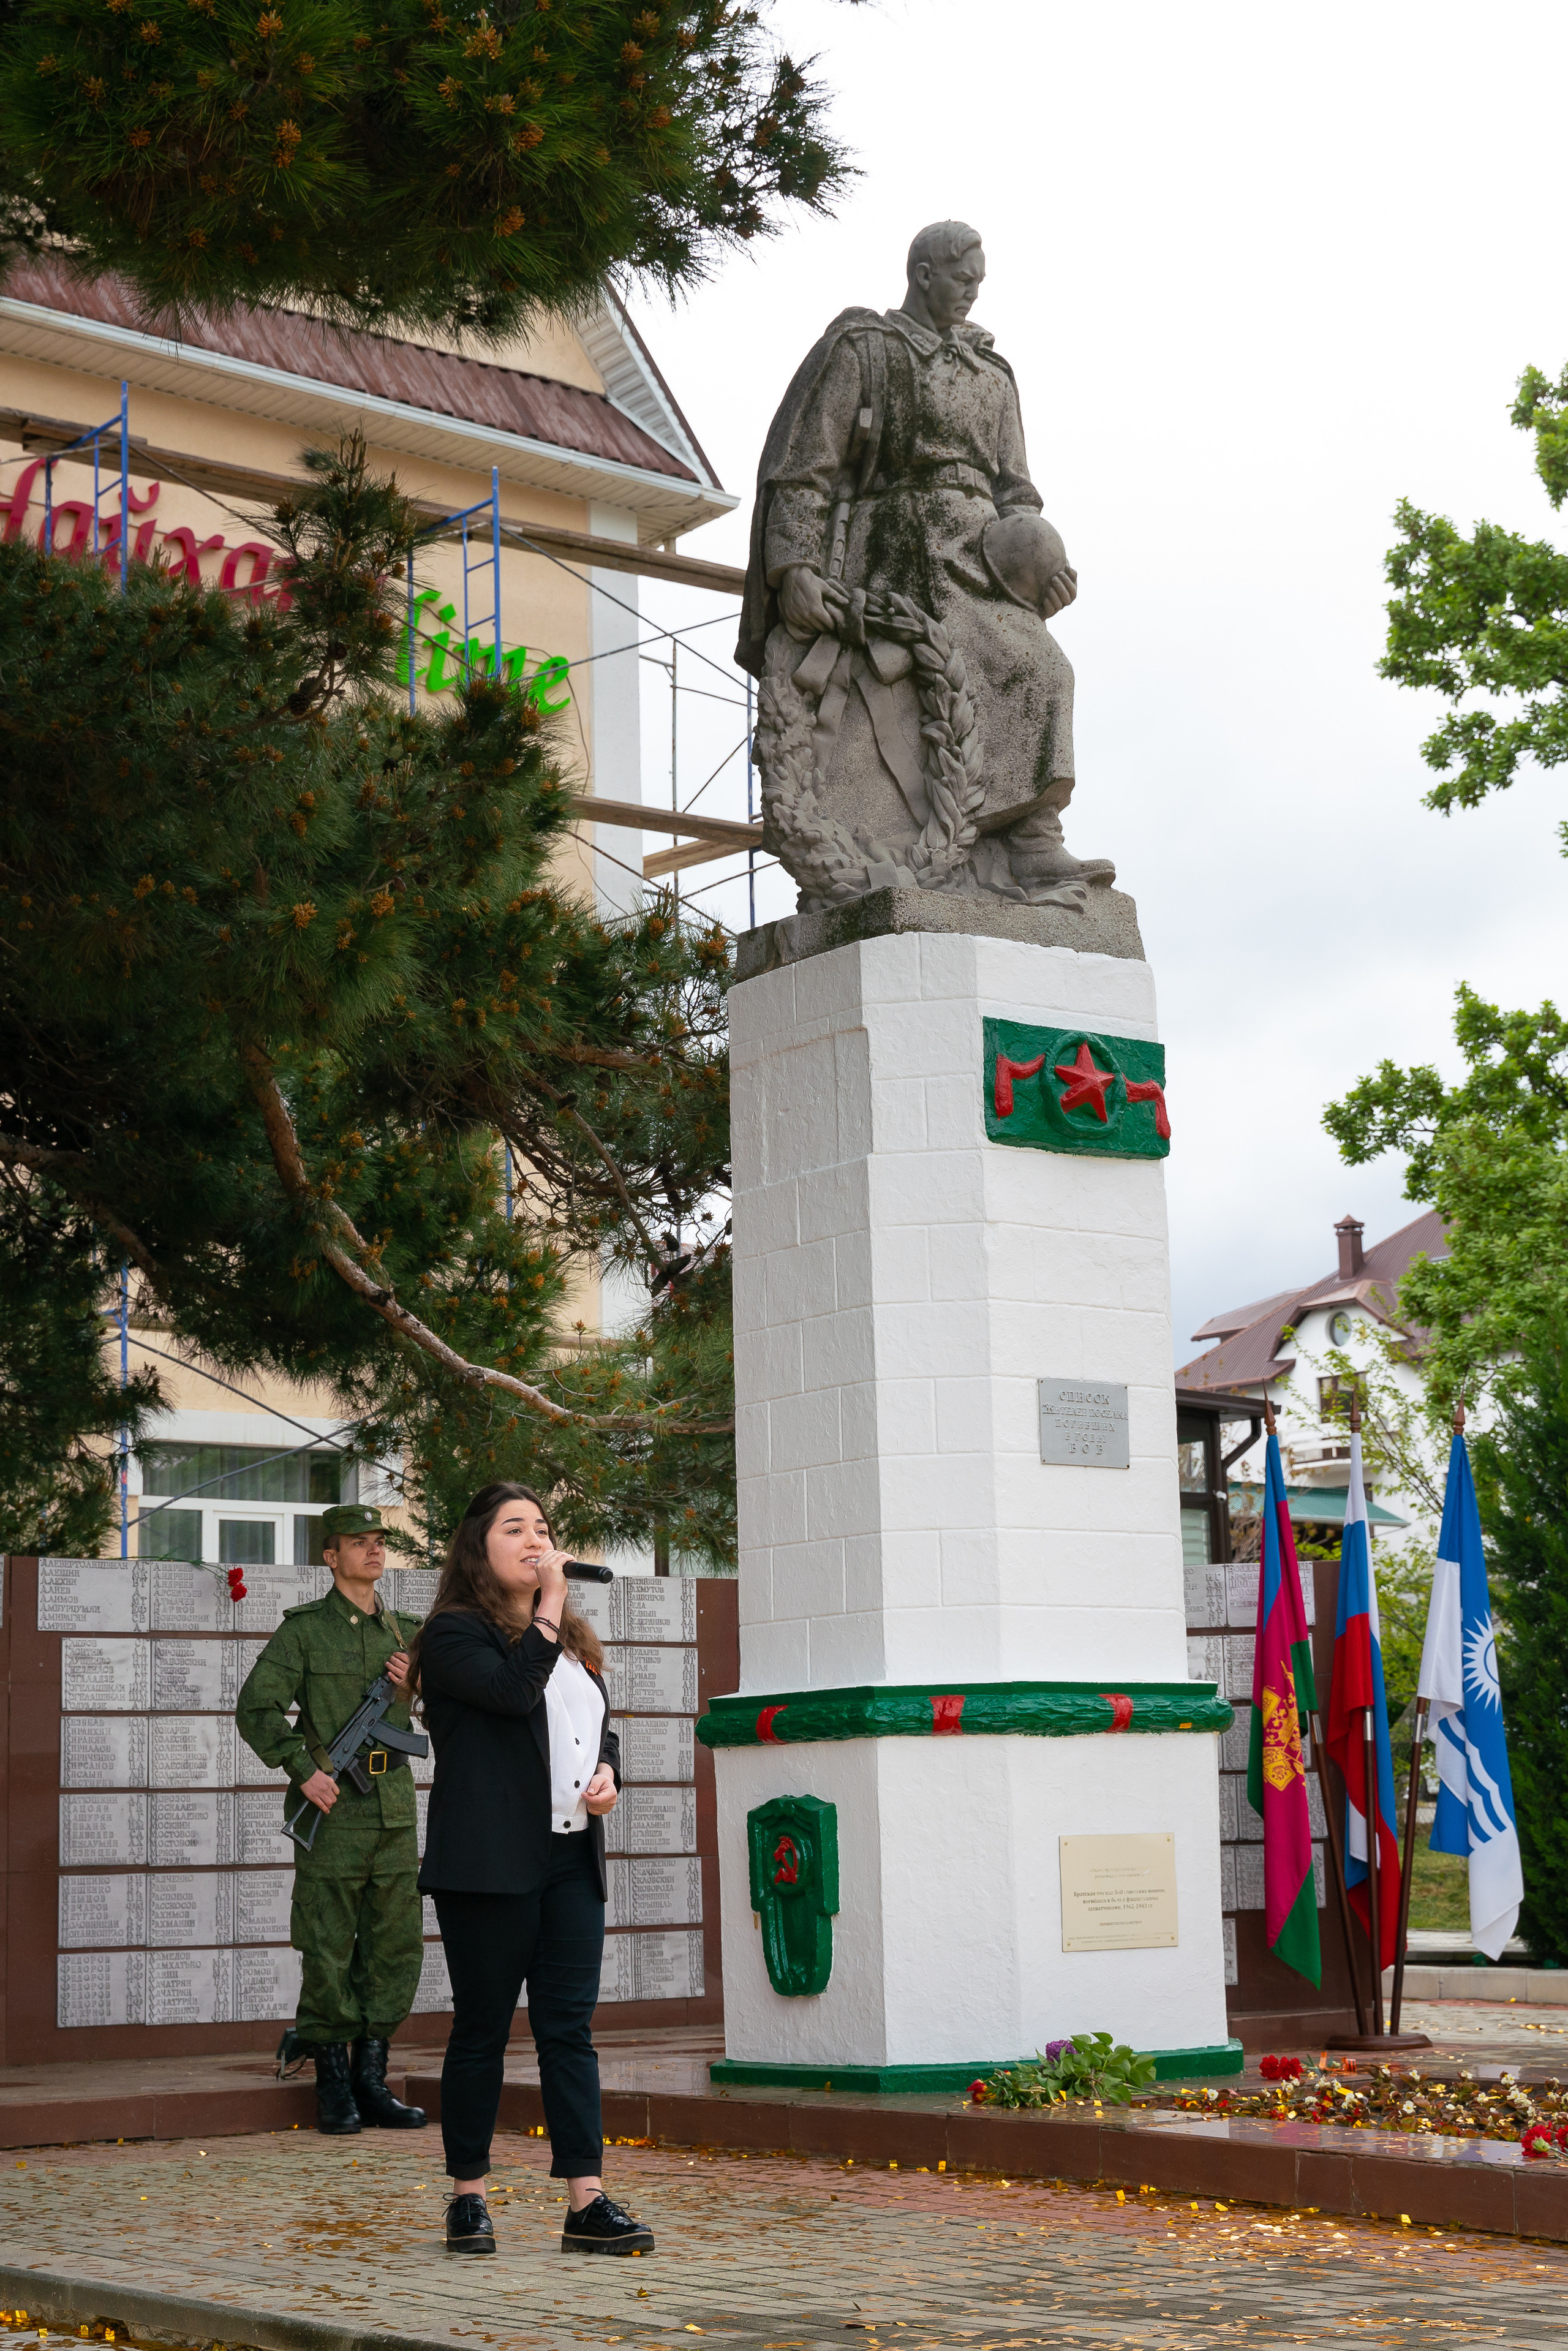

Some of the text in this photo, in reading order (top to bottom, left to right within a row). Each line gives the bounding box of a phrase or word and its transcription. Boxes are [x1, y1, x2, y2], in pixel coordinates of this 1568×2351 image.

[1060, 1391, 1109, 1405] СПИСОК
[1055, 1419, 1115, 1432] ПОГИБШИХ
[40, 1568, 80, 1577] АЛЕШИН
[40, 1577, 77, 1585] АЛЕХИН
[627, 1585, 665, 1593] БАХМУТОВ
[40, 1594, 78, 1603] АЛИМОВ
[627, 1593, 665, 1602] БАШКИРОВ
[628, 1647, 660, 1656] ДУДАРЕВ
[626, 1719, 669, 1727] КОВАЛЕНКО
[152, 1735, 197, 1743] КОЛЕСНИК
[152, 1753, 208, 1761] КОЛЕСНИКОВ
[63, 1762, 114, 1770] КИРСАНОВ
[152, 1761, 208, 1770] КОЛЕСНИКОВ
[151, 1794, 191, 1803] МОРОЗОВ
[151, 1803, 197, 1811] МОСКАЛЕВ
[151, 1811, 208, 1820] МОСКАЛЕНКО
[238, 1837, 271, 1846] МОРГУН
[238, 1846, 282, 1855] МОРГУНОВ
[631, 1868, 665, 1876] СКАЧКОВ
[150, 1874, 194, 1884] РАДЧЕНКО
[150, 1892, 194, 1901] РАСПОПОВ
[150, 1901, 197, 1910] РАССКОСОВ
[238, 1898, 272, 1907] РОЖКОВ
[62, 1903, 108, 1912] ОВЧАРОВ
[62, 1912, 108, 1921] ПЕТУХОВ
[150, 1910, 190, 1919] РАХИМОВ
[238, 1915, 277, 1925] РОМАНОВ
[237, 1958, 275, 1969] ХОЛОДОВ
[237, 1968, 271, 1978] ХРОМОВ
[149, 1979, 192, 1988] ХАЧАТРЯН
[149, 1988, 192, 1998] ХАЧАТРЯН
